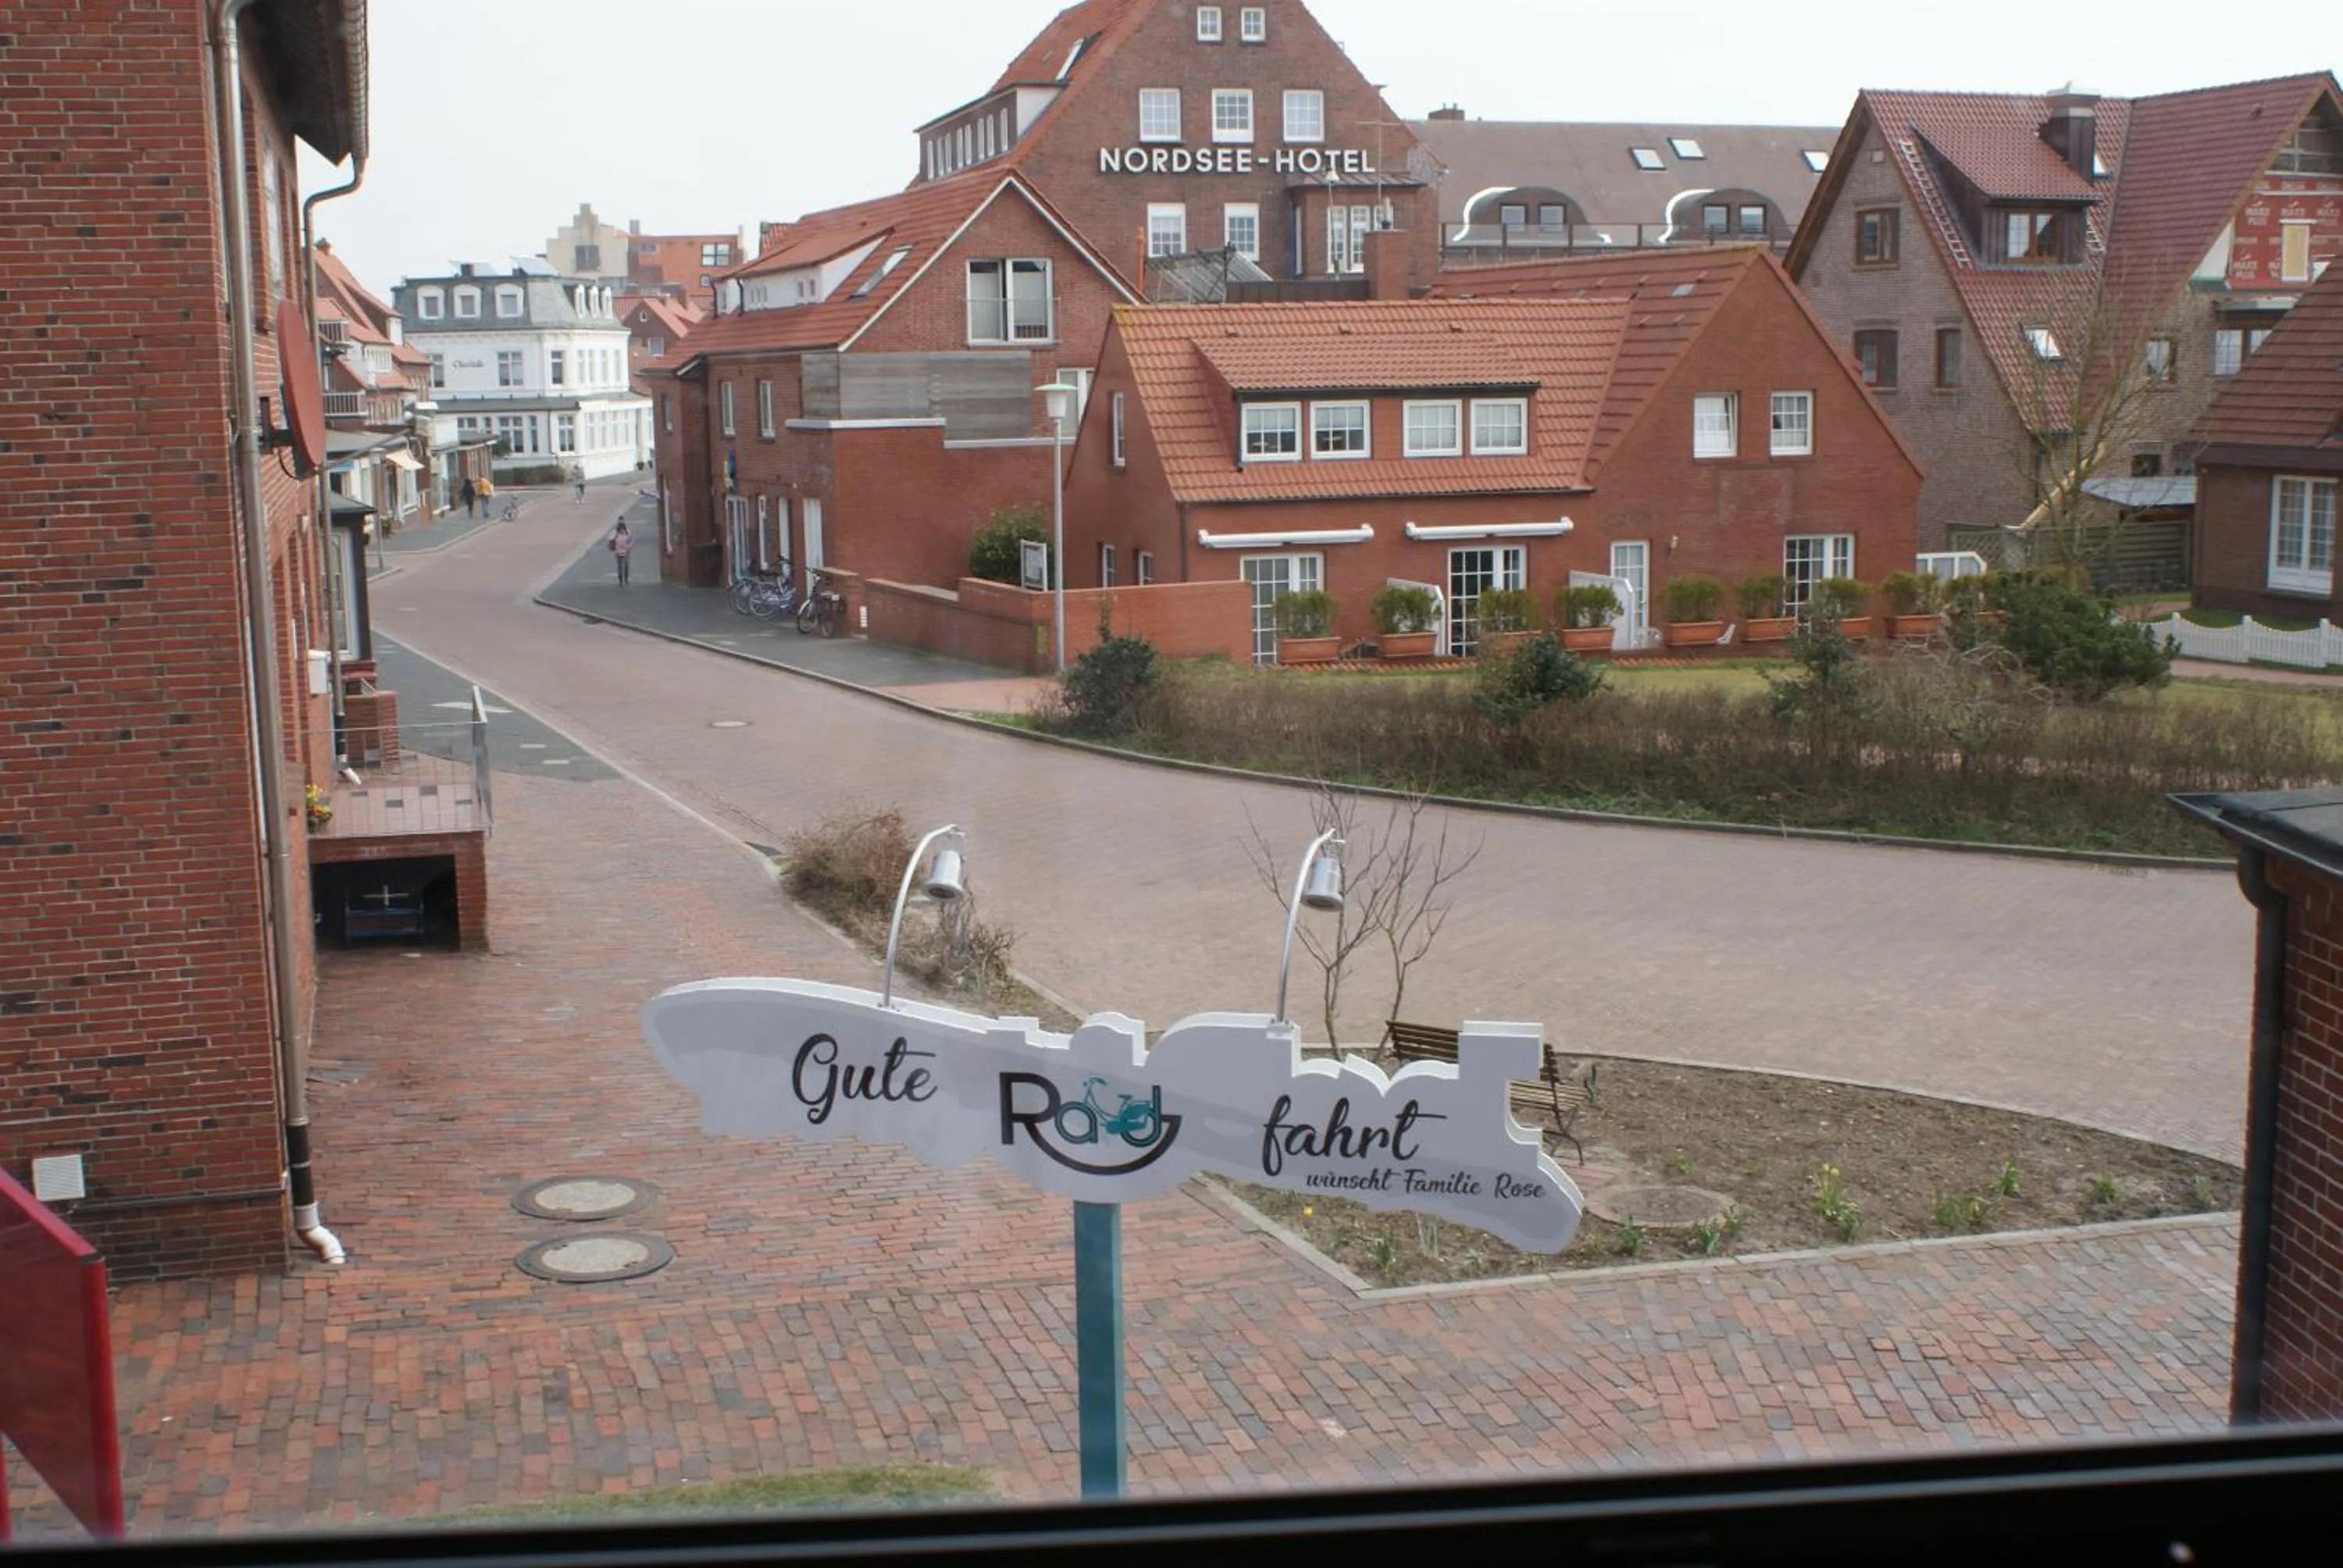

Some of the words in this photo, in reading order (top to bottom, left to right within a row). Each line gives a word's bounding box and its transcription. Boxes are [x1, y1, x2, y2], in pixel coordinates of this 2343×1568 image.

[1099, 147, 1377, 173] NORDSEE-HOTEL
[792, 1033, 937, 1124] Gute
[999, 1071, 1182, 1176] Rad
[1262, 1094, 1448, 1177] fahrt
[1306, 1167, 1402, 1192] wünscht
[1403, 1169, 1482, 1195] Familie
[1493, 1172, 1546, 1199] Rose
